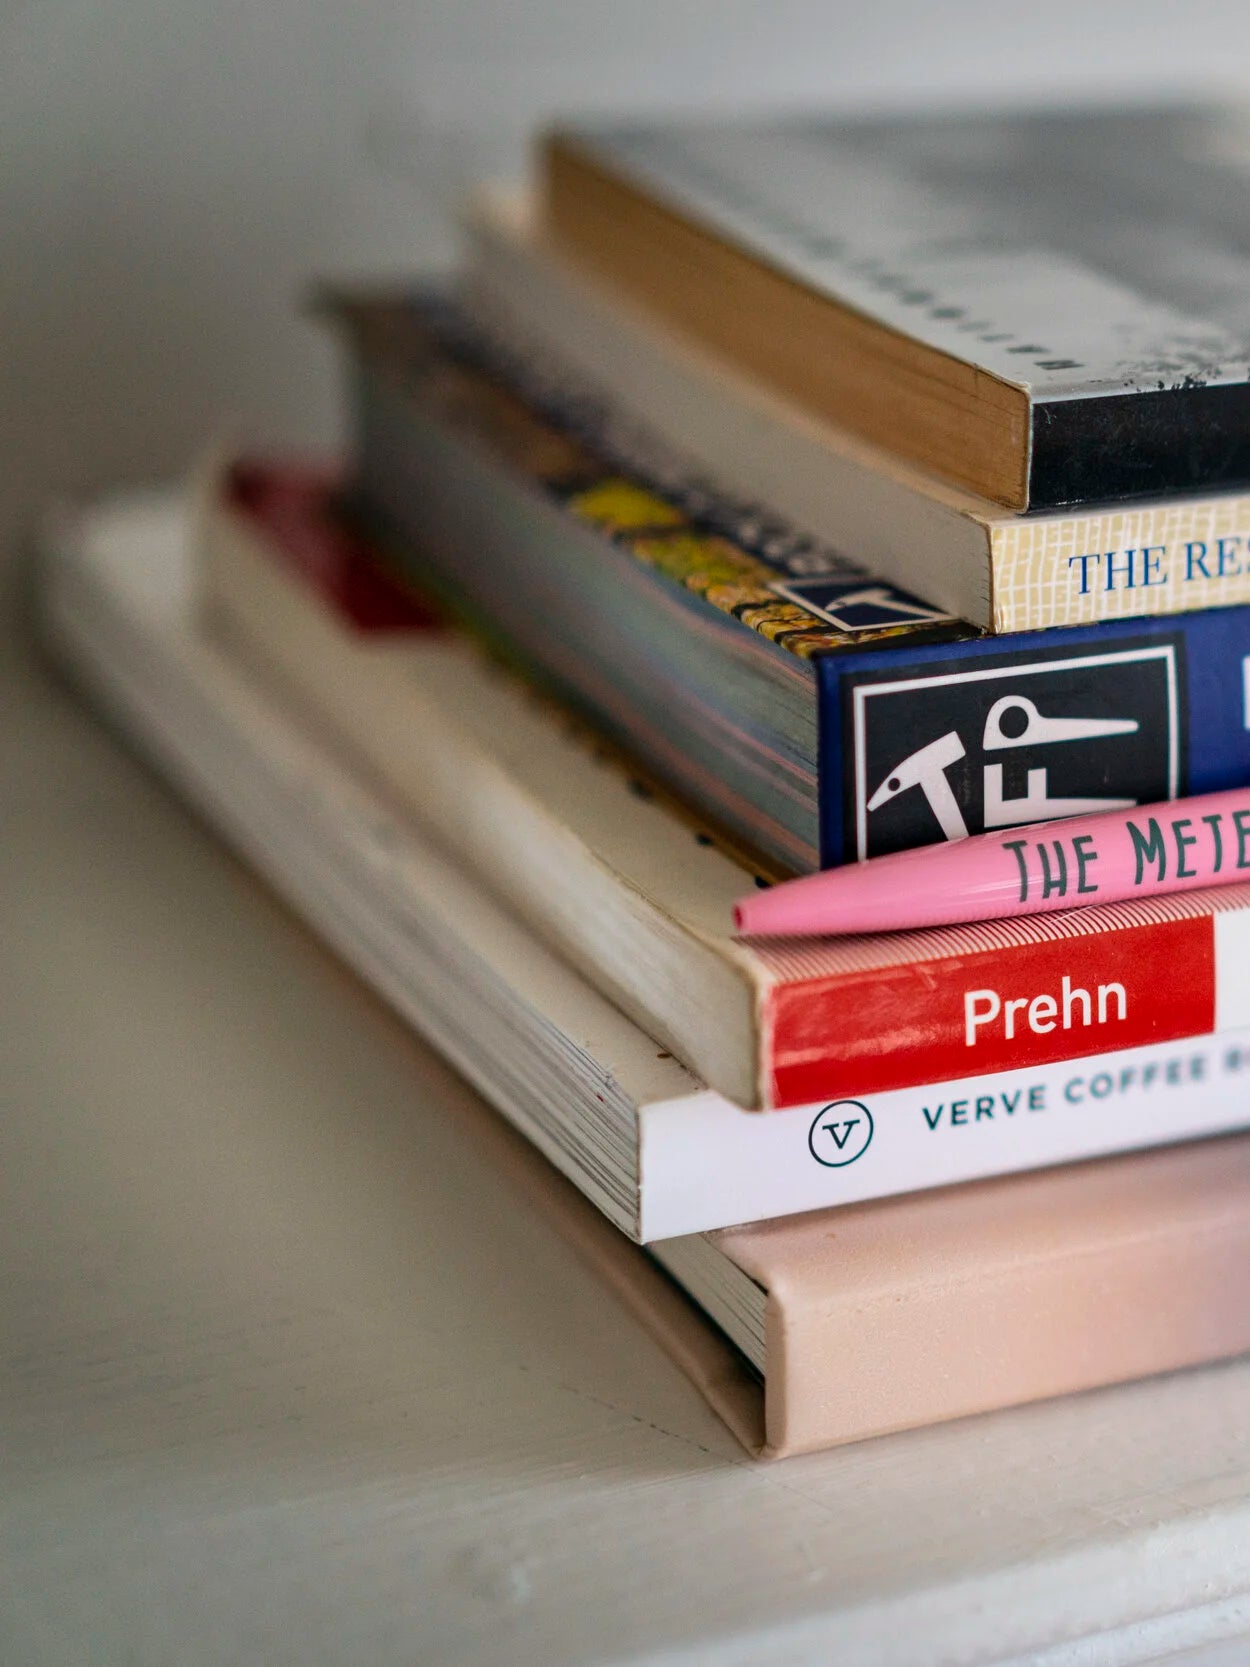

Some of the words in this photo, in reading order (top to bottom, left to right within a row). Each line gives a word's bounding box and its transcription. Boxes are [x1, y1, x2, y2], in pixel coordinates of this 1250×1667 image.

[1068, 545, 1168, 595] THE
[1001, 834, 1099, 902] THE
[964, 974, 1128, 1047] Prehn
[921, 1084, 1048, 1132] VERVE
[1063, 1053, 1209, 1102] COFFEE
[821, 1119, 861, 1151] V
